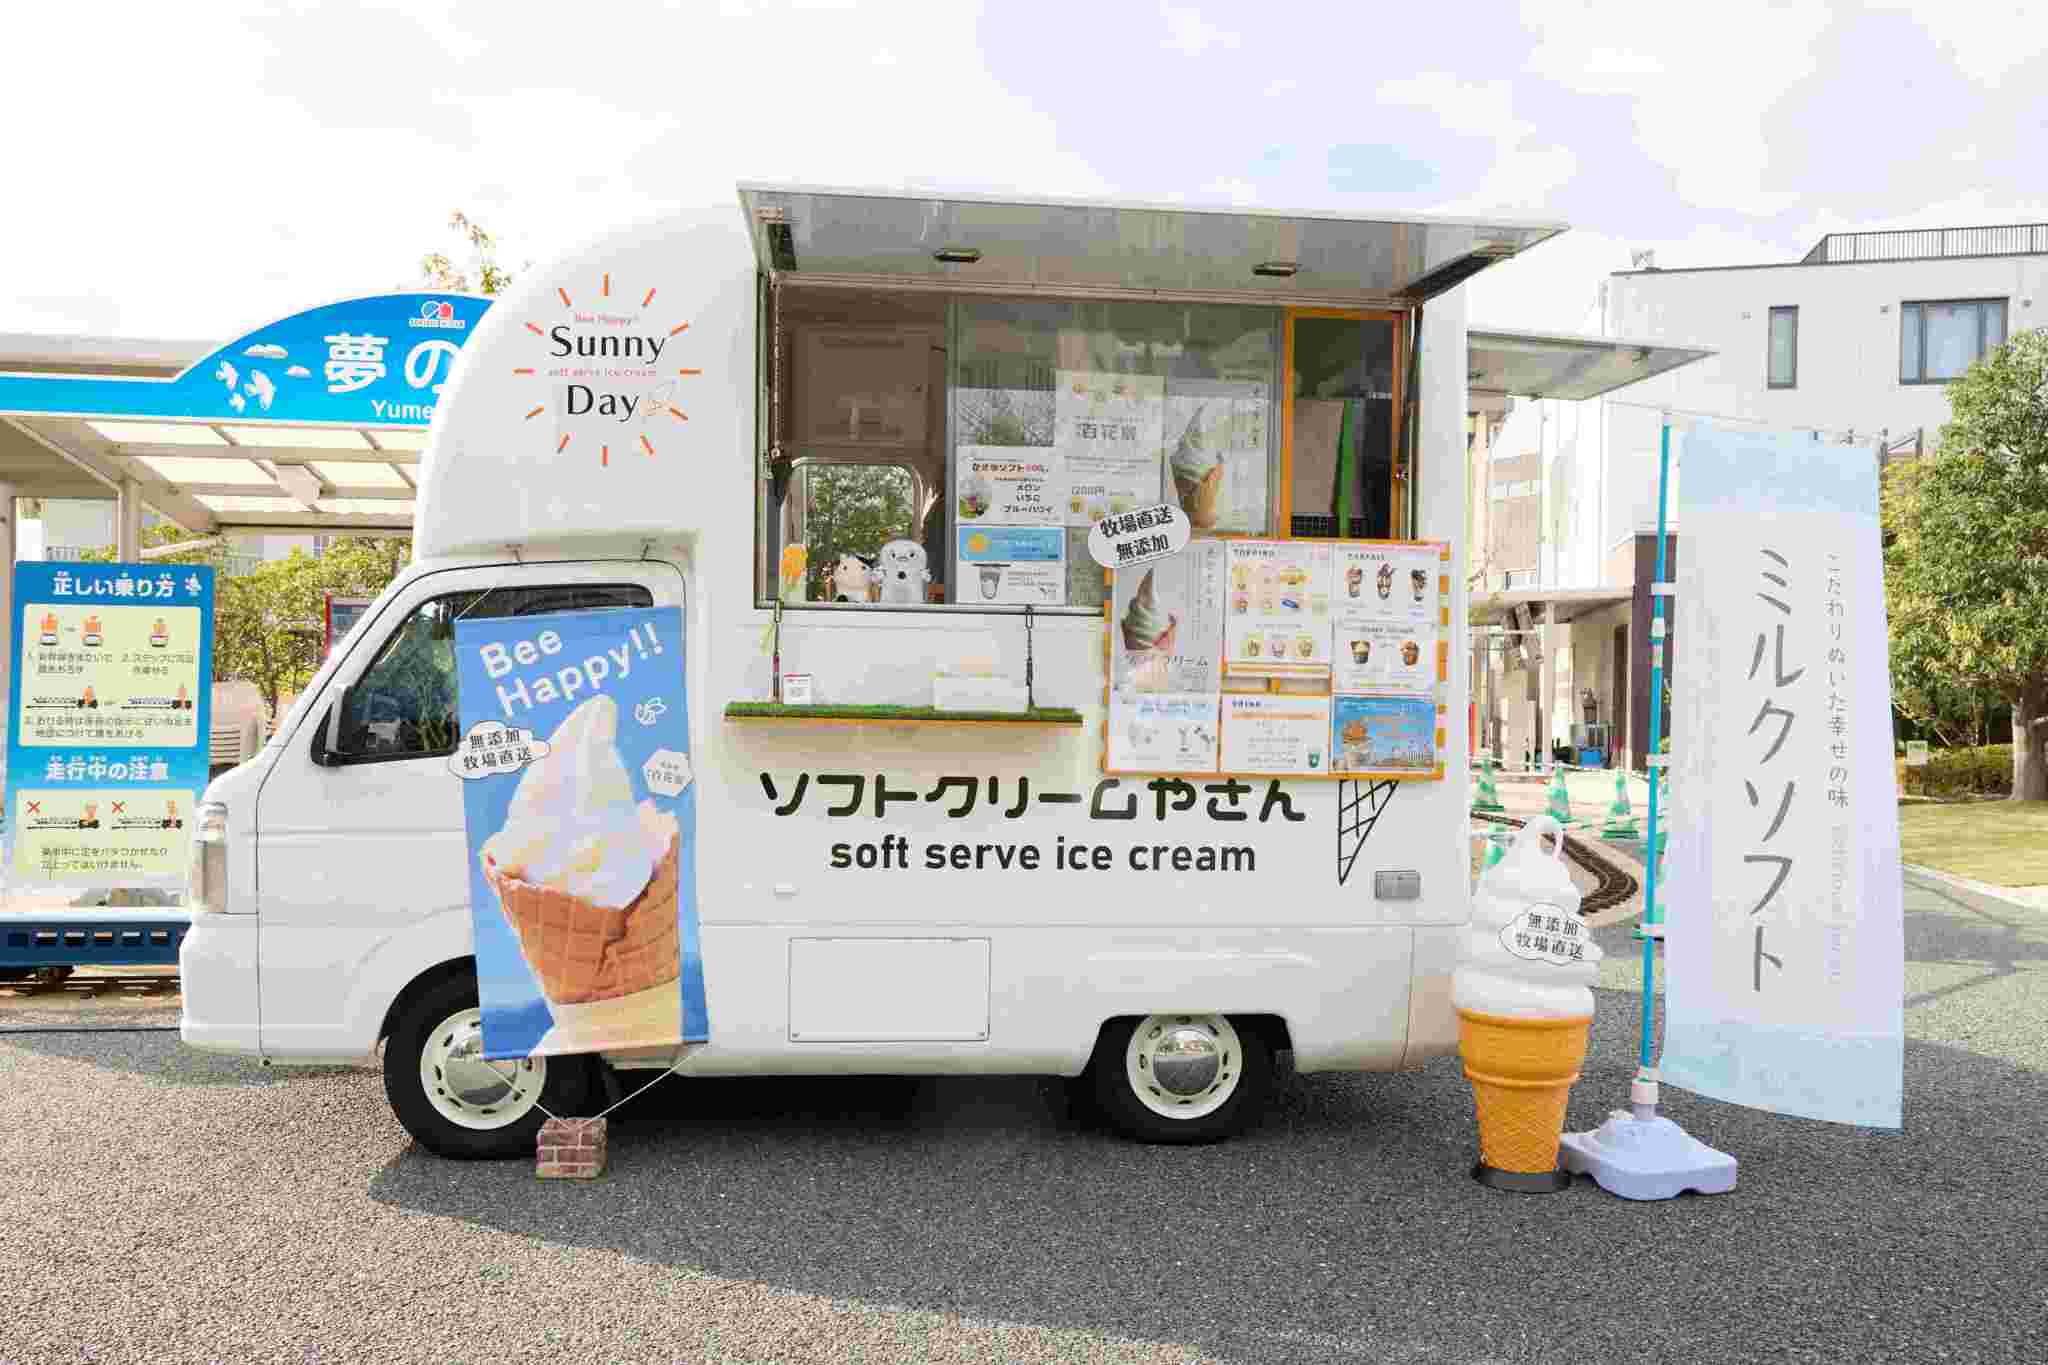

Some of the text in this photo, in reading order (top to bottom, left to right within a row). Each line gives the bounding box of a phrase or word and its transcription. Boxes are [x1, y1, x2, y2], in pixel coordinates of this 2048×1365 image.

[551, 325, 666, 364] Sunny
[324, 332, 461, 393] 夢の
[371, 400, 433, 419] Yume
[567, 384, 640, 423] Day
[1100, 505, 1175, 540] 牧場直送
[1116, 534, 1169, 562] 無添加
[53, 576, 175, 597] 正しい乗り方
[480, 630, 563, 678] Bee
[496, 622, 664, 721] Happy!!
[1824, 552, 1849, 809] こだわりぬいた幸せの味
[470, 729, 521, 750] 無添加
[45, 759, 169, 781] 走行中の注意
[463, 746, 532, 770] 牧場直送
[1744, 548, 1806, 993] ミルクソフト
[760, 773, 1306, 821] ソフトクリームやさん
[830, 836, 1256, 870] soft serve ice cream
[1527, 912, 1578, 936] 無添加
[1515, 932, 1585, 960] 牧場直送
